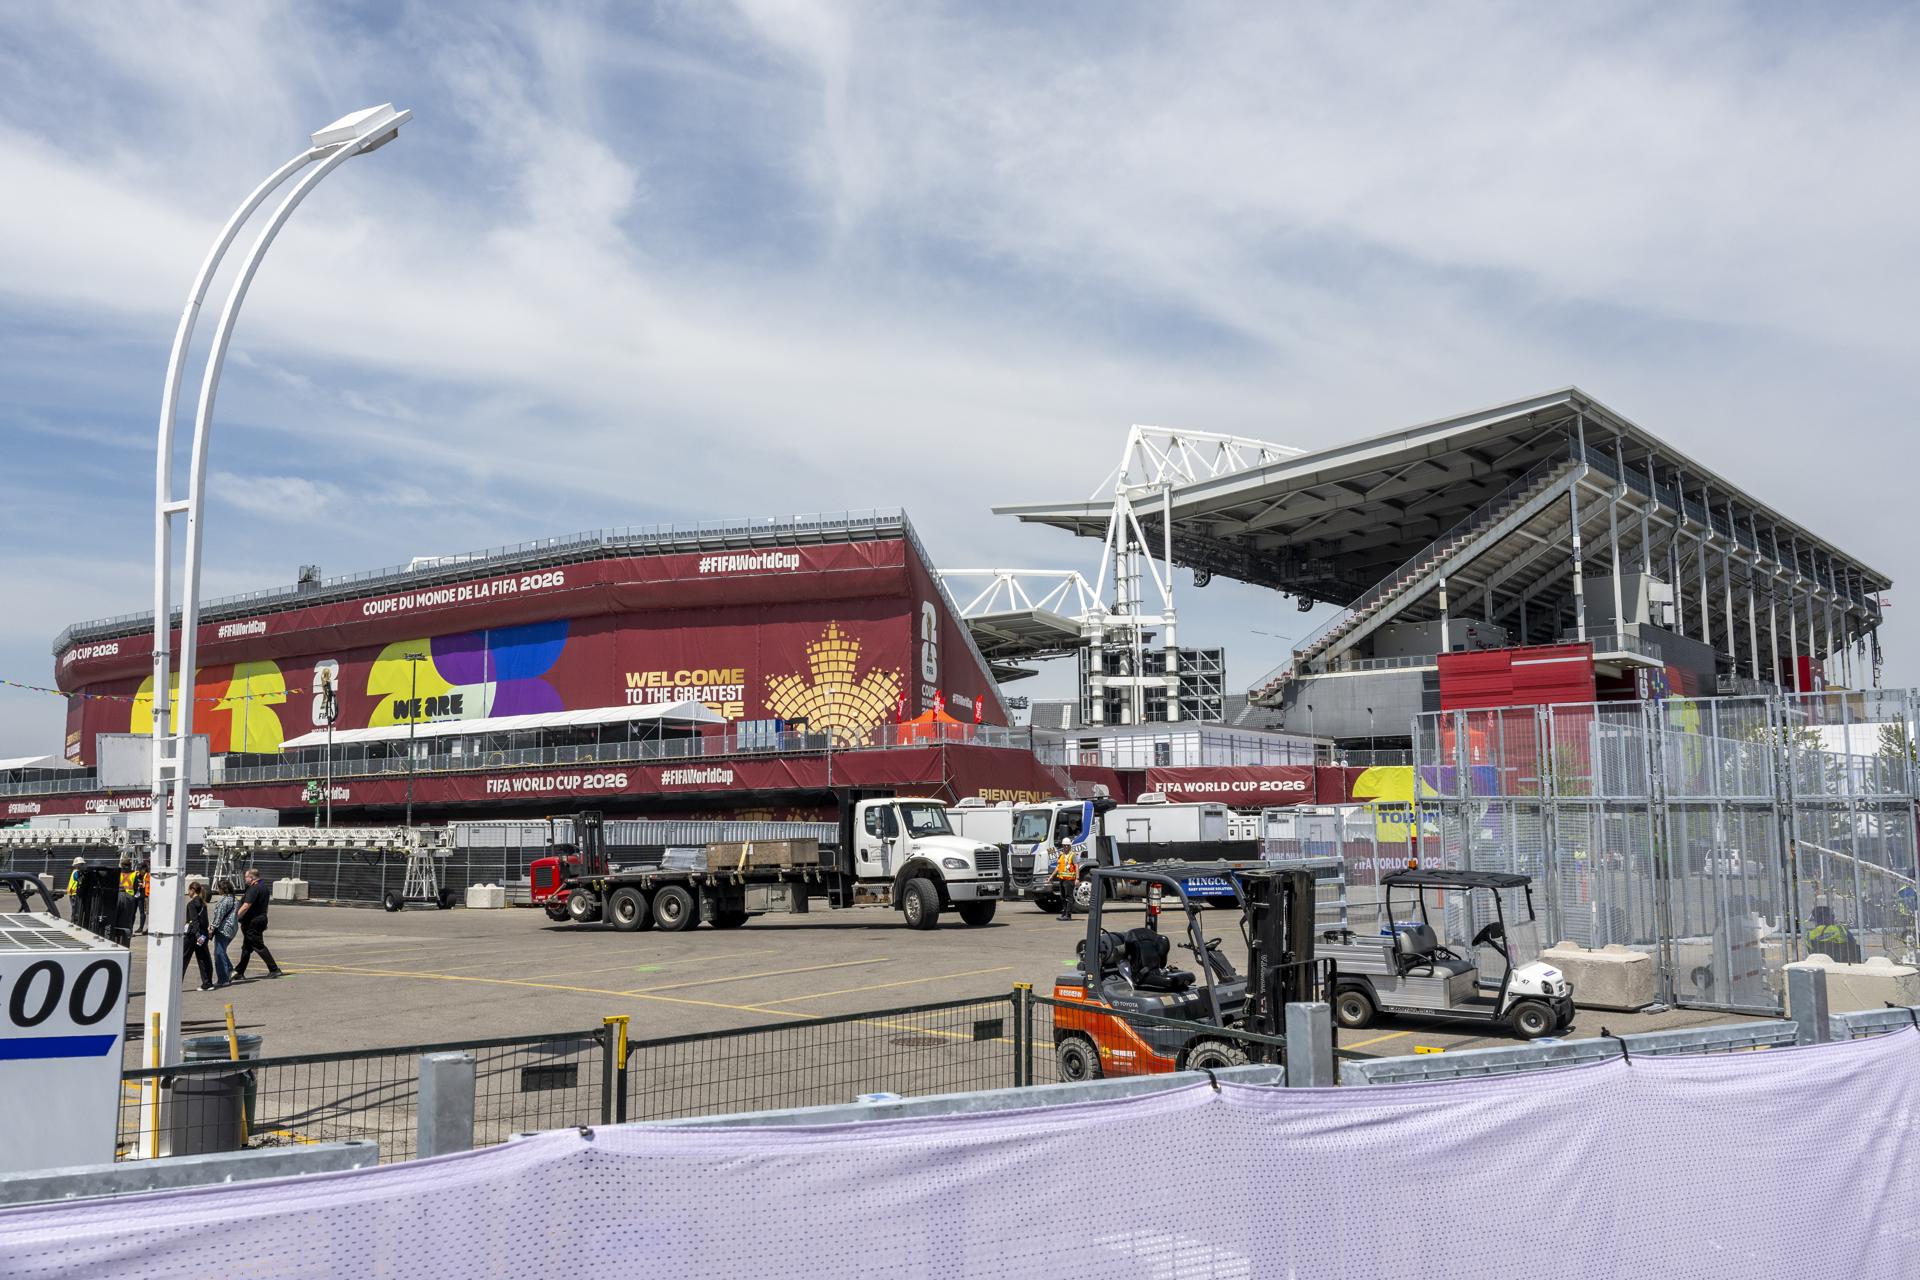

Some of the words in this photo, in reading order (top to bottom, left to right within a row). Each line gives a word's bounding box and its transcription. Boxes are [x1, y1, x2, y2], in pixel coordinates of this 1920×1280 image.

[699, 552, 800, 573] #FIFAWorldCup
[363, 599, 397, 615] COUPE
[399, 598, 414, 610] DU
[416, 588, 455, 608] MONDE
[457, 585, 472, 600] DE
[474, 583, 489, 598] LA
[491, 578, 517, 595] FIFA
[520, 571, 565, 591] 2026
[218, 620, 266, 638] #FIFAWorldCup
[77, 647, 92, 660] CUP
[92, 643, 119, 658] 2026
[625, 668, 745, 687] WELCOME
[625, 688, 643, 704] TO
[646, 687, 672, 703] THE
[674, 685, 745, 702] GREATEST
[393, 698, 422, 719] WE
[486, 779, 511, 793] FIFA
[512, 776, 555, 791] WORLD
[556, 775, 581, 790] CUP
[583, 773, 628, 789] 2026
[661, 767, 734, 785] #FIFAWorldCup
[1155, 782, 1182, 792] FIFA
[1183, 782, 1230, 792] WORLD
[1232, 781, 1258, 791] CUP
[1259, 780, 1306, 791] 2026
[120, 797, 145, 809] MONDE
